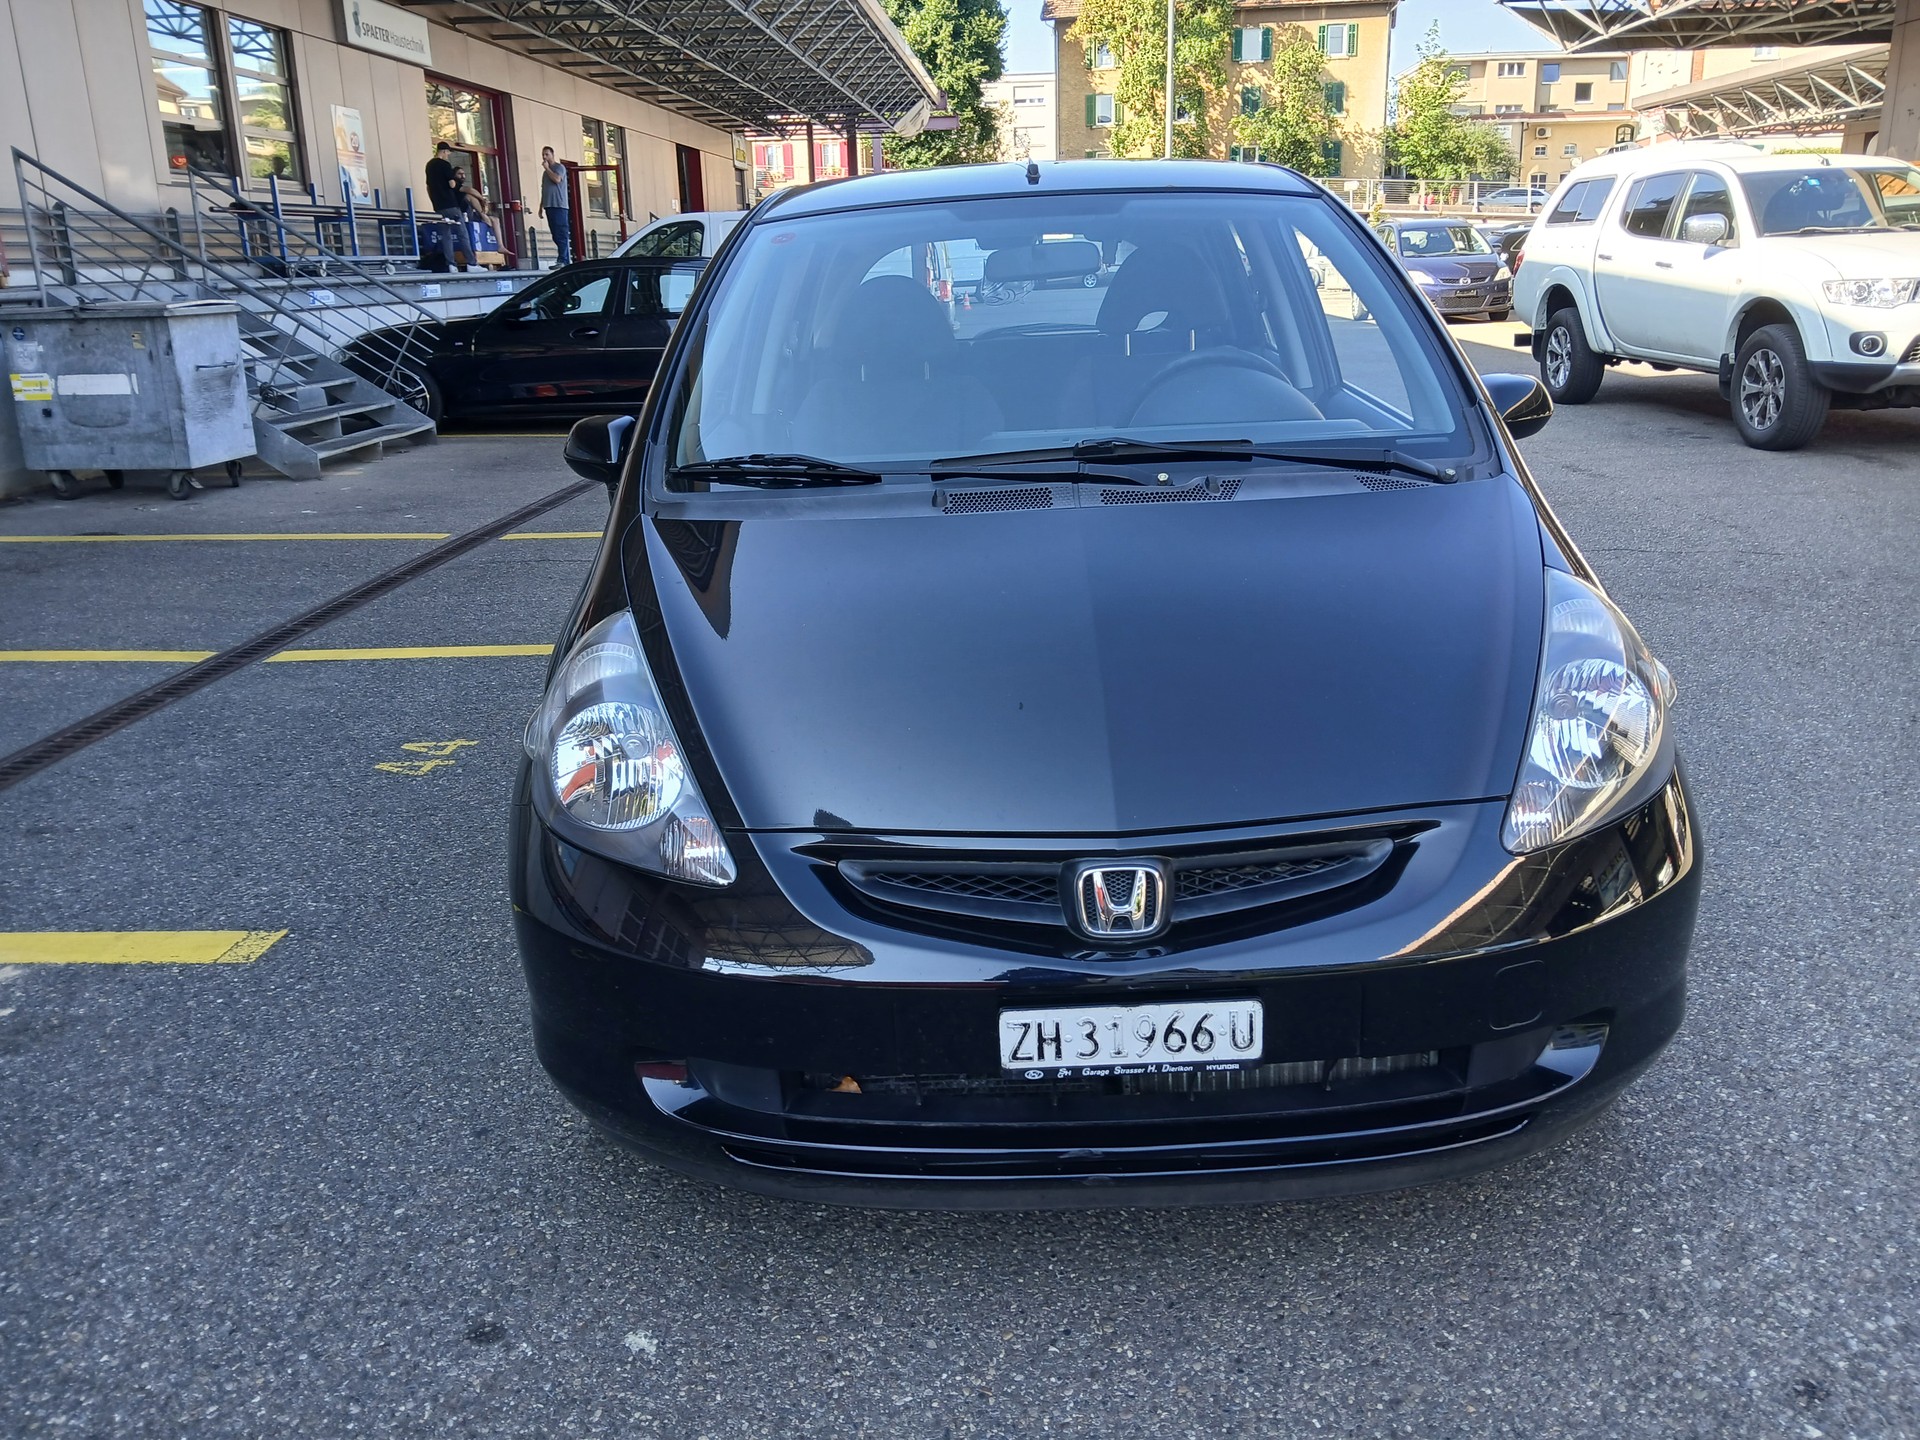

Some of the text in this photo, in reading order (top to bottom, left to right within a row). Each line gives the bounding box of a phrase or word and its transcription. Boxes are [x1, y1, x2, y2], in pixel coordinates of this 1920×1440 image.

[361, 21, 425, 54] SPAETER Haustechnik
[1082, 1067, 1110, 1077] Garage
[1113, 1065, 1146, 1075] Strasser
[1161, 1063, 1194, 1073] Dierikon
[1206, 1063, 1240, 1071] HYUNDAI
